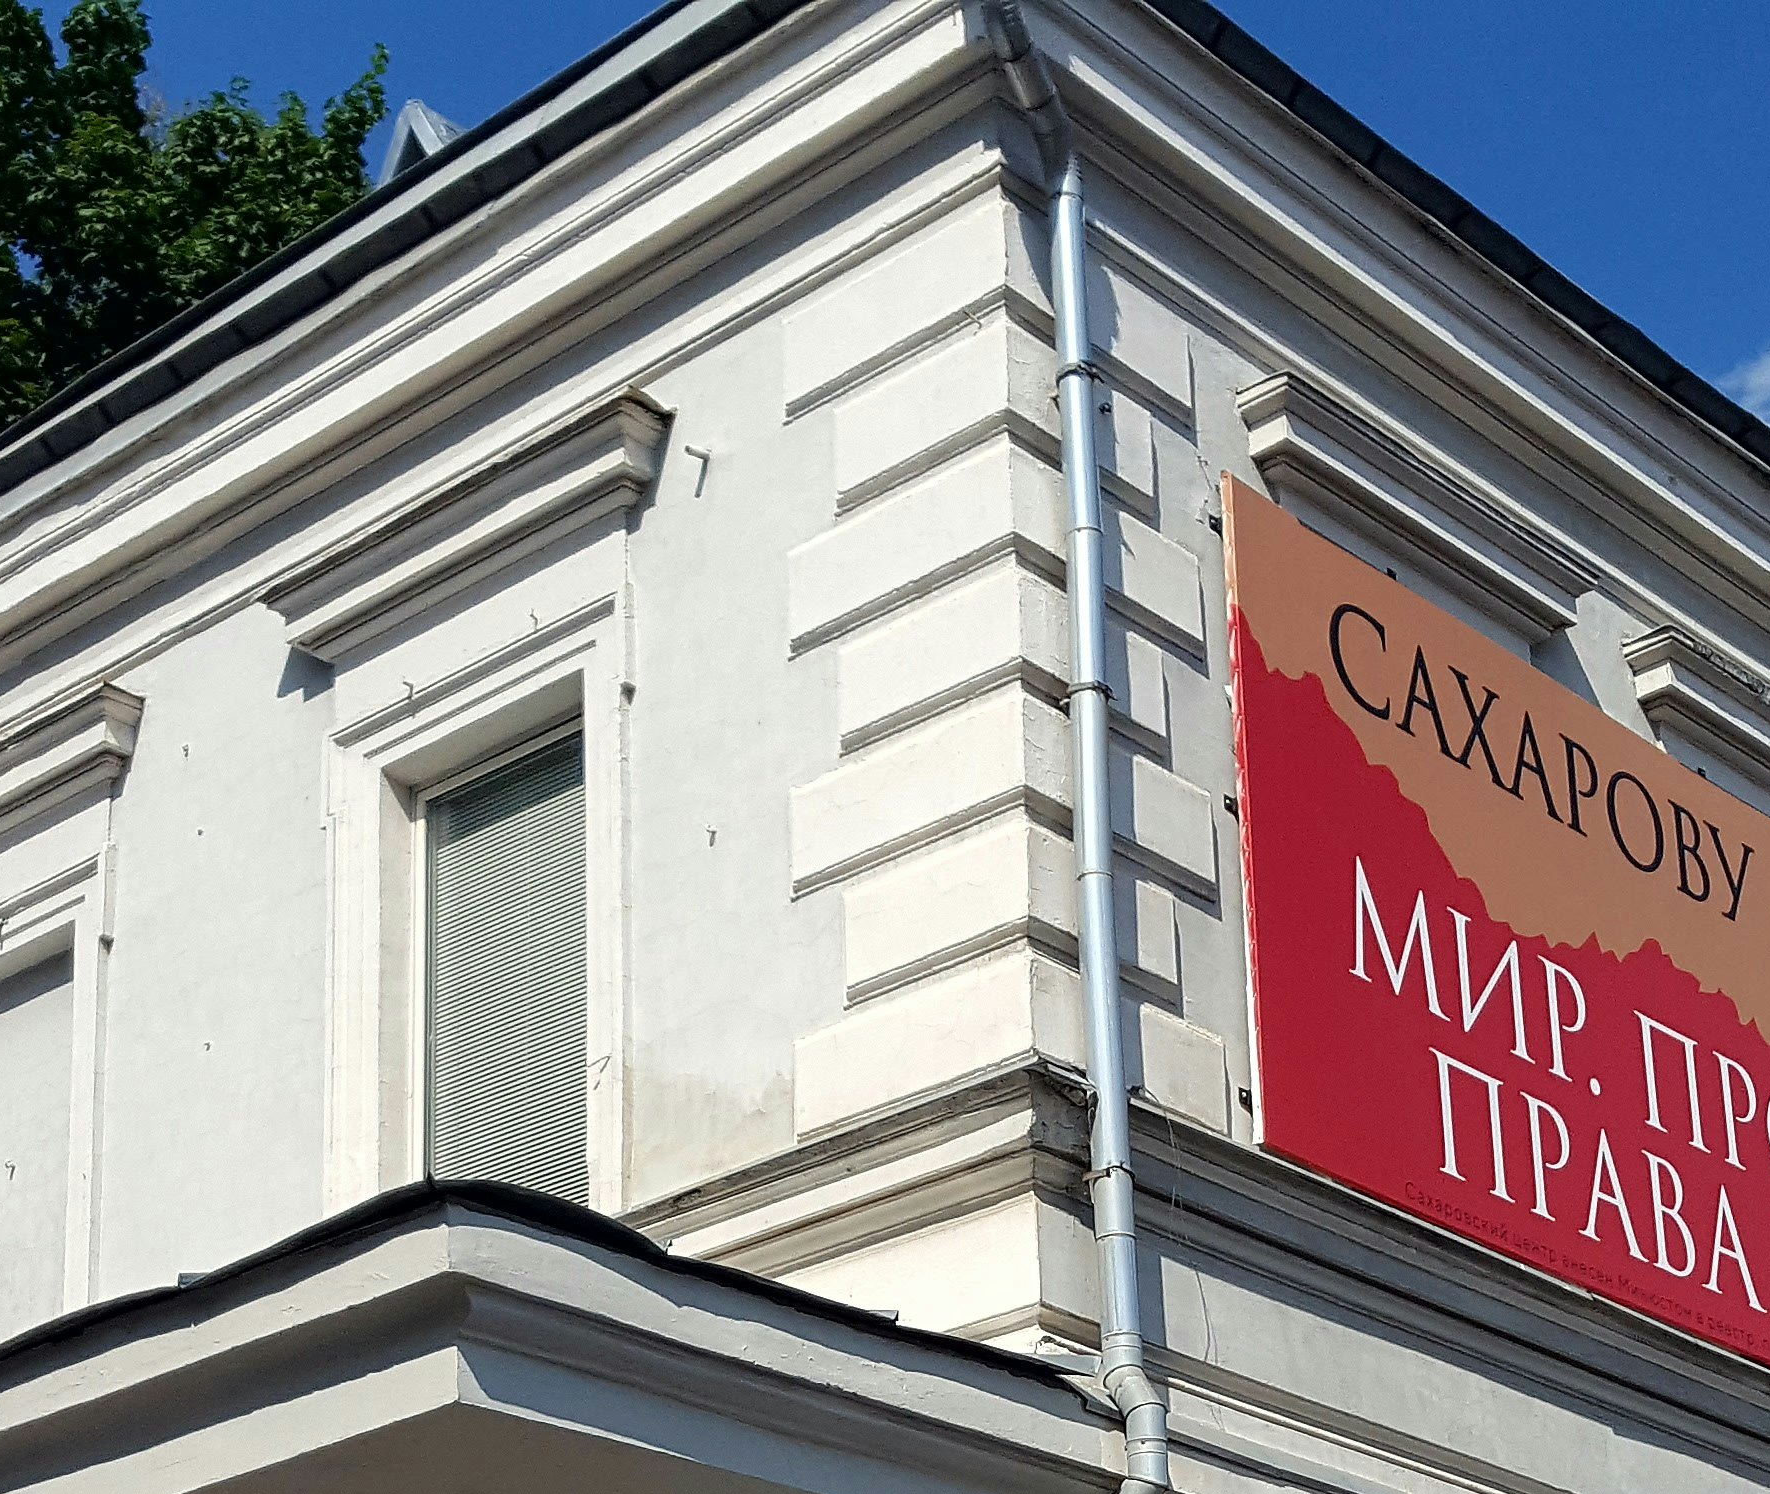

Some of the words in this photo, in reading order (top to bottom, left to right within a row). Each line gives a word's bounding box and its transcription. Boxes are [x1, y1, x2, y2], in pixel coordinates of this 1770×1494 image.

[1328, 602, 1754, 922] САХАРОВУ
[1348, 855, 1601, 1096] МИР.
[1404, 1181, 1507, 1242] Сахаровский
[1428, 1046, 1768, 1314] ПРАВА
